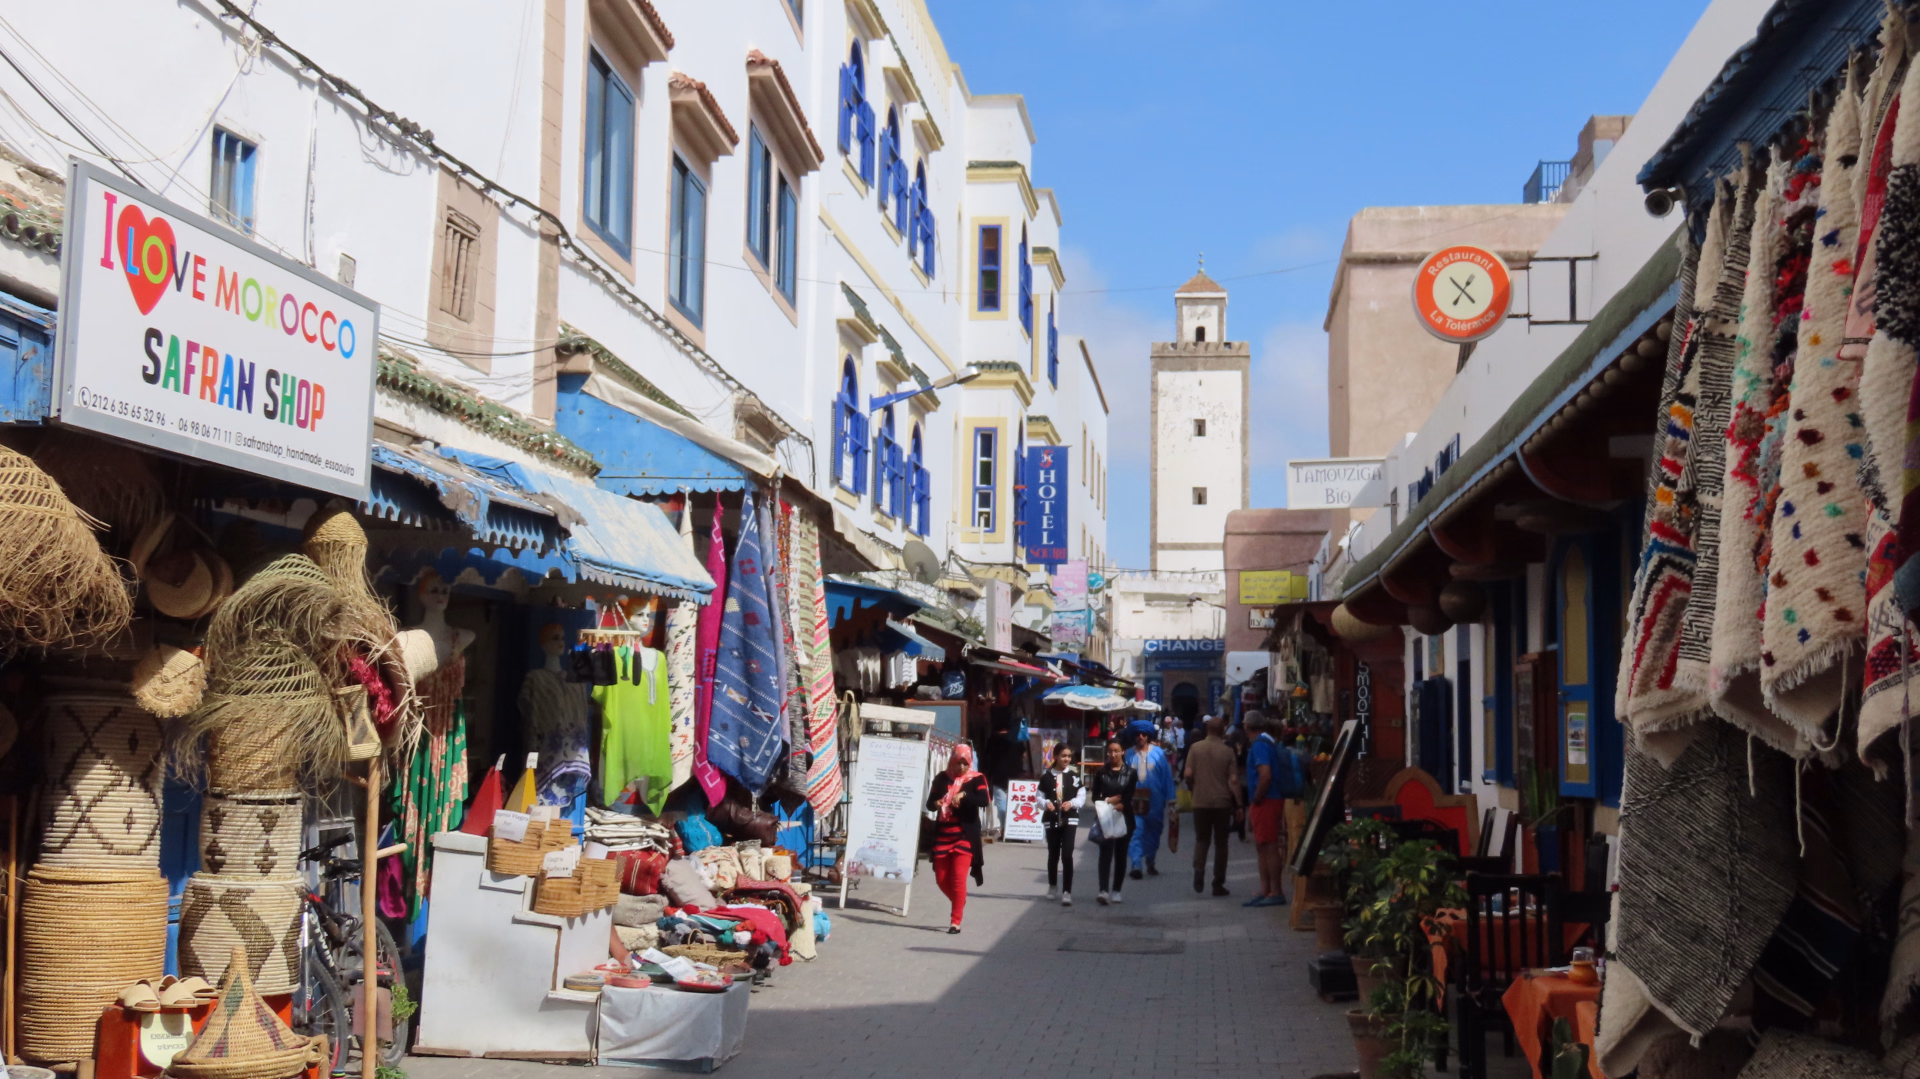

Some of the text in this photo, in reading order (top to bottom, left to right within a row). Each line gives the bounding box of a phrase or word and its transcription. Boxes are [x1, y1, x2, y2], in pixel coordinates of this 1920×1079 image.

[100, 191, 355, 359] I LOVE MOROCCO
[1428, 252, 1493, 276] Restaurant
[1430, 310, 1496, 331] La Tolérance
[142, 327, 325, 432] SAFRAN SHOP
[92, 394, 108, 410] 212
[111, 399, 116, 413] 6
[118, 401, 129, 416] 35
[131, 405, 142, 419] 65
[144, 408, 154, 423] 32
[156, 411, 166, 426] 96
[178, 418, 188, 432] 06
[190, 421, 199, 435] 98
[201, 424, 210, 438] 06
[213, 427, 221, 441] 71
[224, 430, 232, 443] 11
[1038, 469, 1056, 545] HOTEL
[1145, 640, 1225, 652] CHANGE
[1012, 783, 1026, 792] Le
